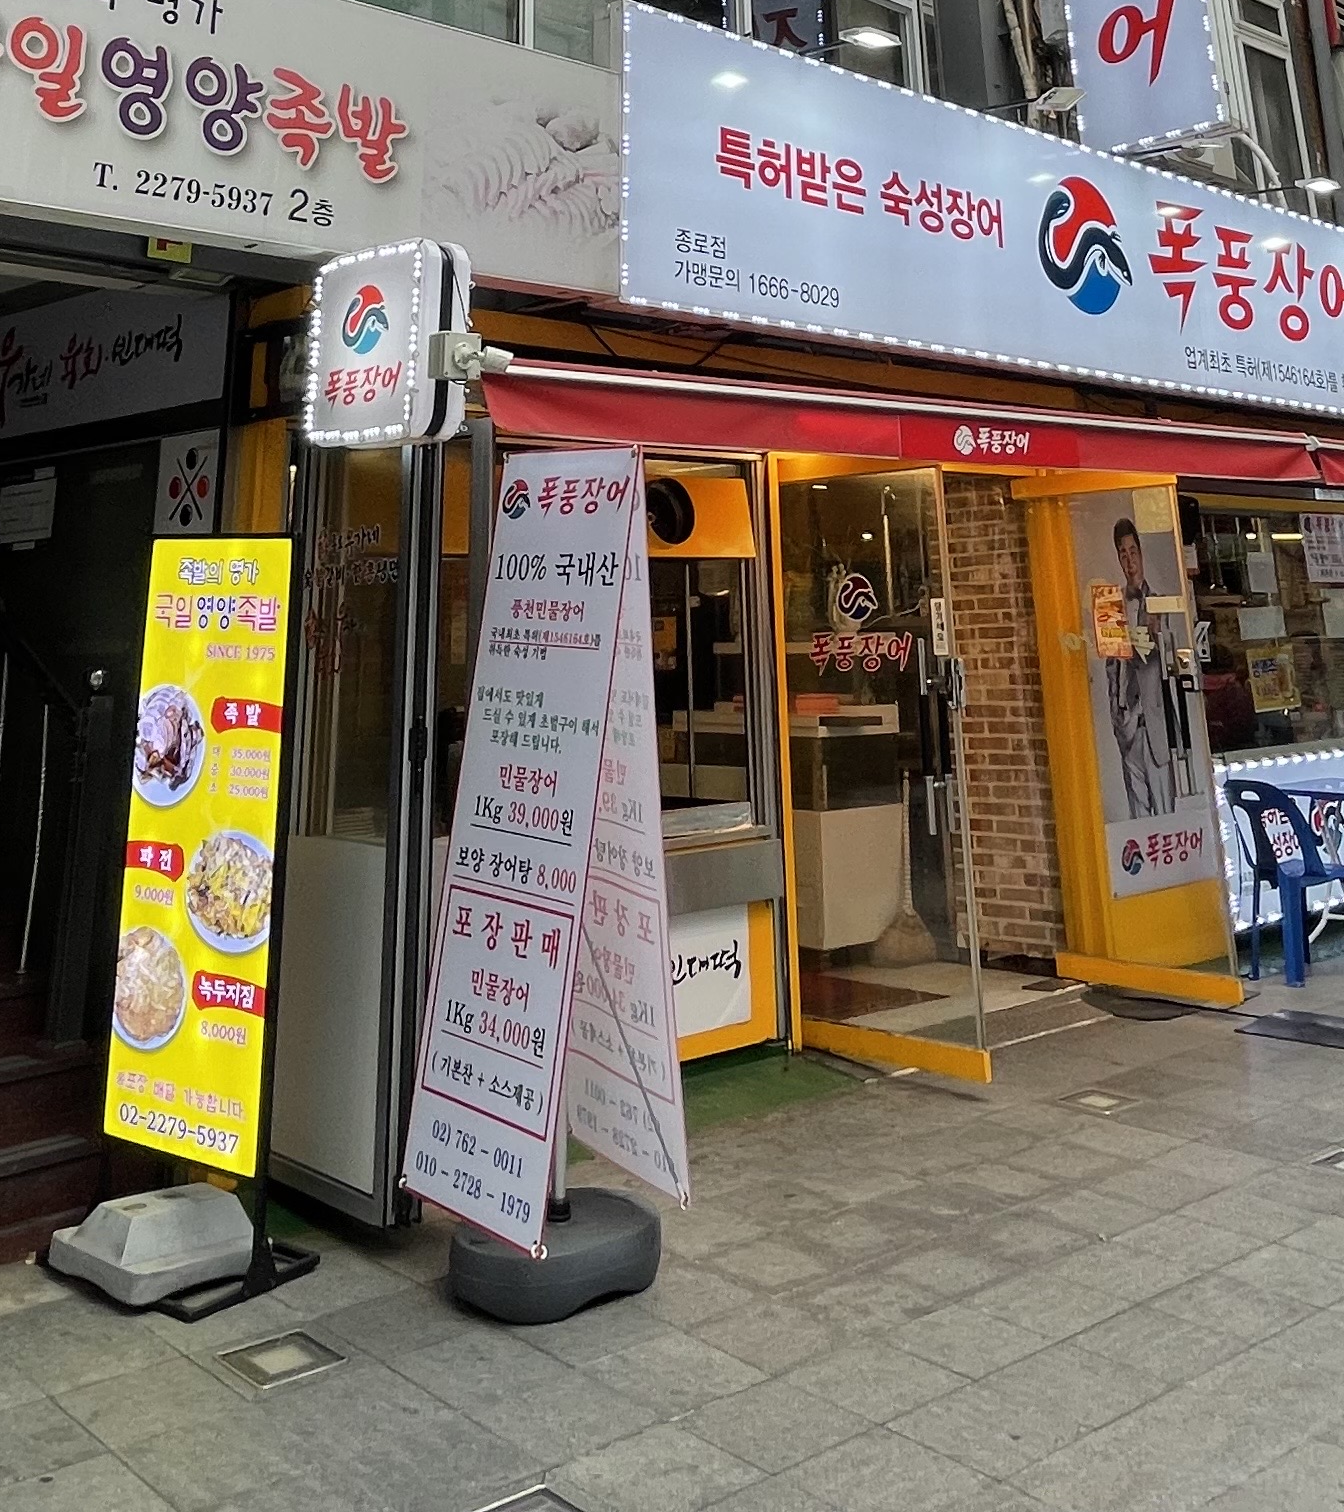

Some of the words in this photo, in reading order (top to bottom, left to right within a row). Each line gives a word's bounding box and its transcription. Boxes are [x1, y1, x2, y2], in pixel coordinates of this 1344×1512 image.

[94, 161, 120, 194] T.
[134, 168, 275, 218] 2279-5937
[287, 188, 337, 229] 2층
[714, 124, 868, 218] 특허받은
[880, 169, 1008, 250] 숙성장어
[673, 226, 728, 260] 종로점
[673, 259, 742, 295] 가맹문의
[748, 271, 842, 310] 1666-8029
[1183, 345, 1233, 374] 업계최초
[325, 360, 404, 407] 폭풍장어
[976, 428, 1030, 456] 폭풍장어
[537, 474, 631, 518] 폭풍장어
[179, 557, 224, 586] 족발의
[228, 558, 260, 586] 명가
[493, 552, 548, 582] 100%
[554, 551, 620, 588] 국내산
[155, 593, 281, 632] 국일영양족발
[510, 598, 586, 623] 풍천민물장어
[206, 644, 241, 660] SINCE
[246, 646, 276, 662] 1975
[531, 646, 548, 661] 기법
[810, 631, 913, 677] 폭풍장어
[505, 710, 515, 725] 수
[581, 717, 600, 737] 해서
[498, 762, 558, 799] 민물장어
[473, 794, 504, 825] 1Kg
[1145, 829, 1204, 867] 폭풍장어
[456, 846, 486, 873] 보양
[488, 851, 532, 885] 장어탕
[535, 863, 576, 895] 8,000
[197, 975, 256, 1010] 녹두지짐
[469, 966, 531, 1012] 민물장어
[444, 996, 475, 1032] 1Kg
[119, 1103, 239, 1154] 02-2279-5937
[455, 1126, 477, 1155] 762
[493, 1147, 524, 1180] 0011
[415, 1148, 438, 1178] 010
[453, 1167, 483, 1201] 2728
[499, 1190, 532, 1225] 1979
